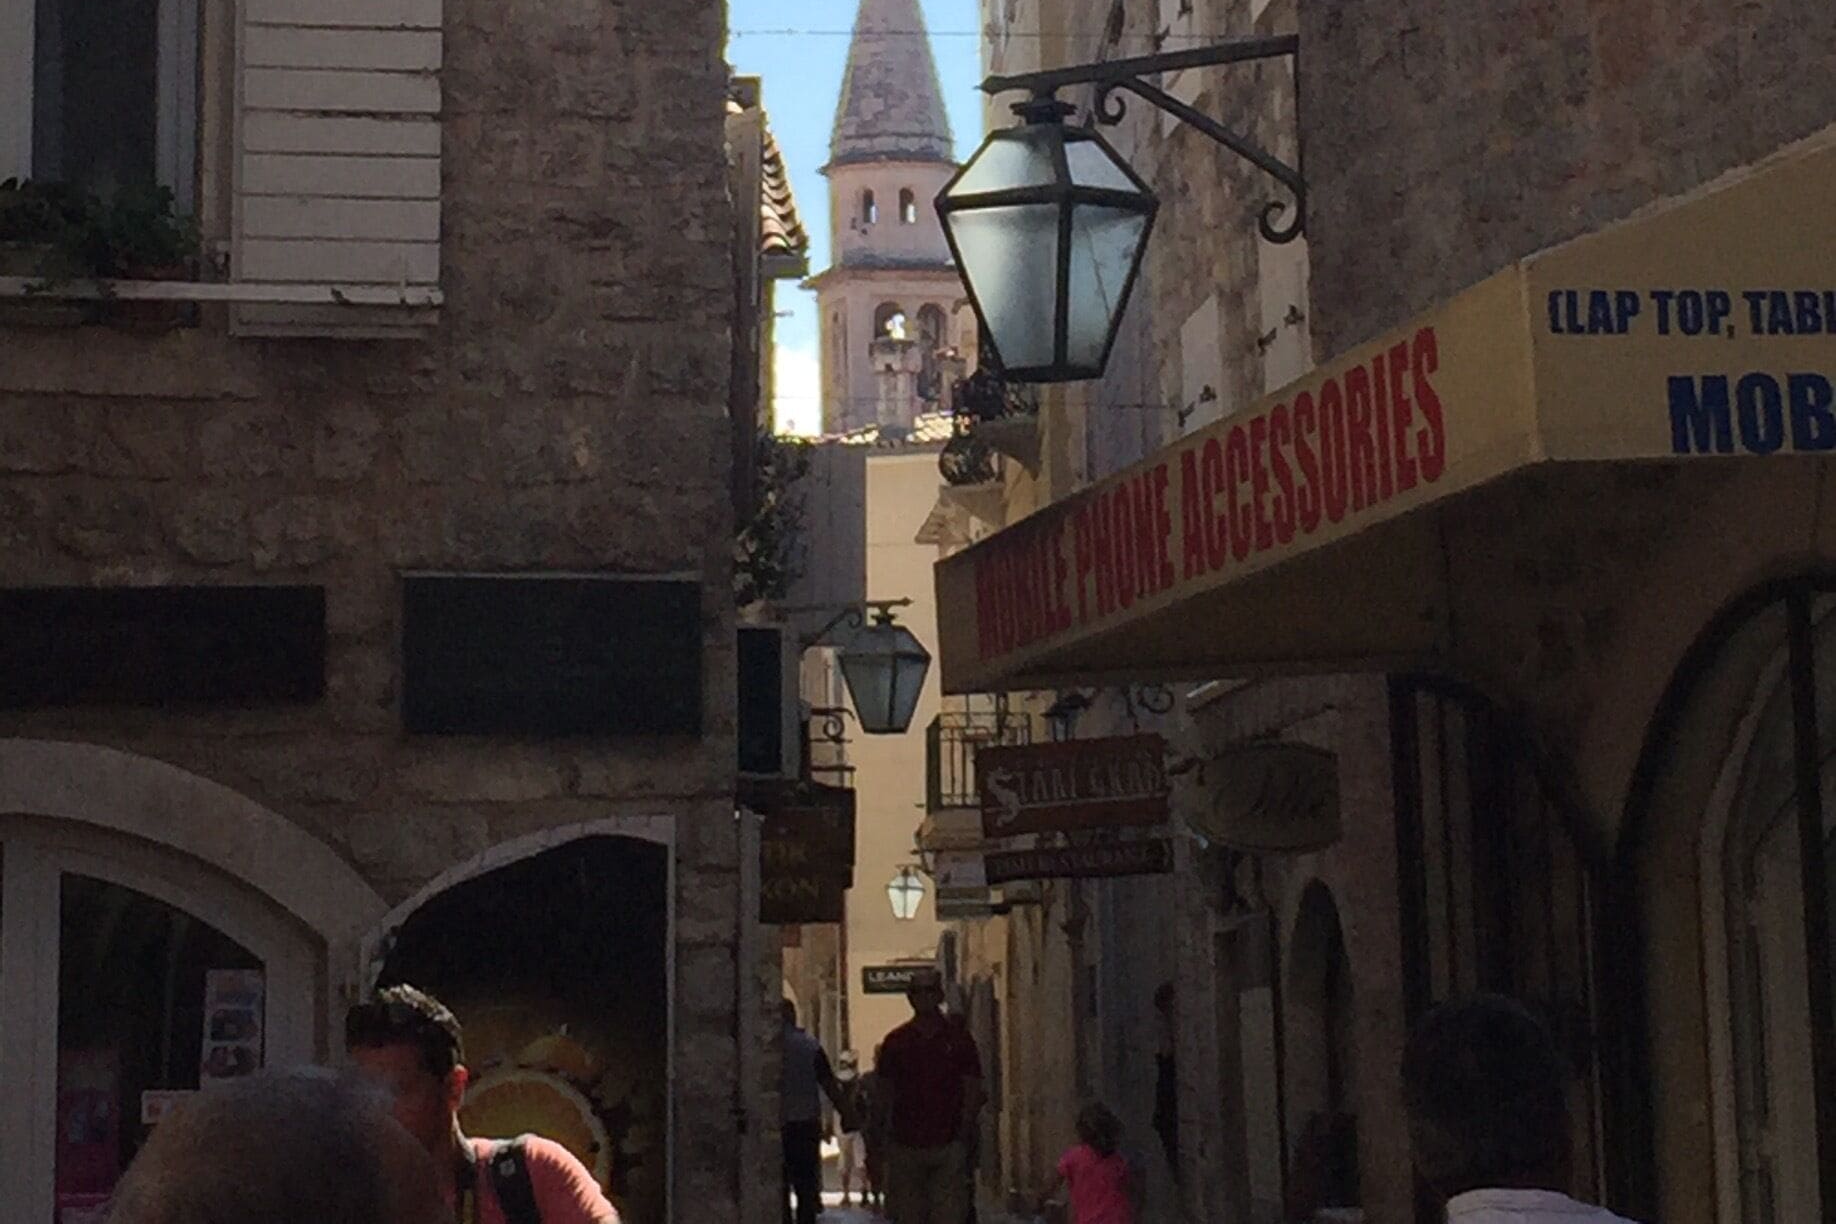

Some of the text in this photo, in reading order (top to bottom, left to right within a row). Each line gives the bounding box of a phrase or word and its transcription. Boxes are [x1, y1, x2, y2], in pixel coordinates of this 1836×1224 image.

[1649, 290, 1734, 339] TOP,
[1667, 372, 1836, 454] MOB
[975, 326, 1446, 659] MOBILE PHONE ACCESSORIES
